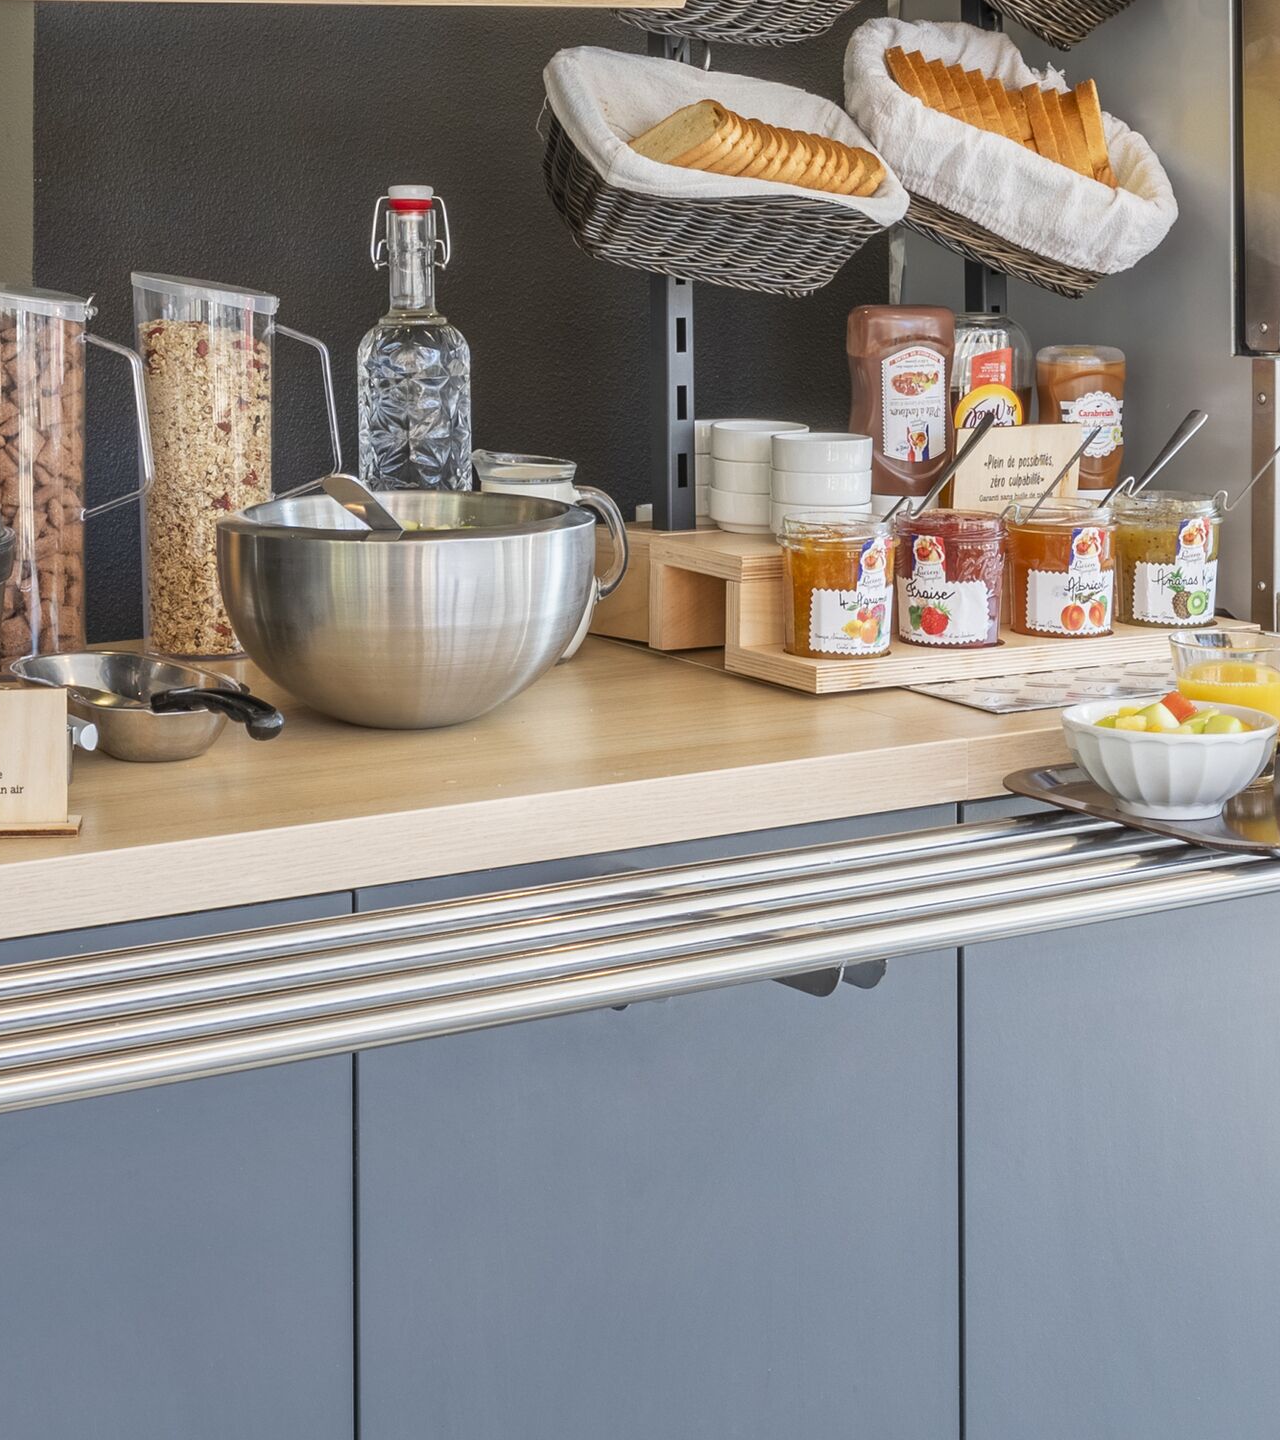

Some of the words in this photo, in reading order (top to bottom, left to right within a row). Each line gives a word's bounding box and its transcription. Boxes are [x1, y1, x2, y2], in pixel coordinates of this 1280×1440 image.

[1007, 455, 1015, 468] de
[906, 578, 956, 600] Fraise
[1152, 568, 1199, 596] Ananas
[839, 592, 848, 610] 4
[10, 785, 24, 794] air
